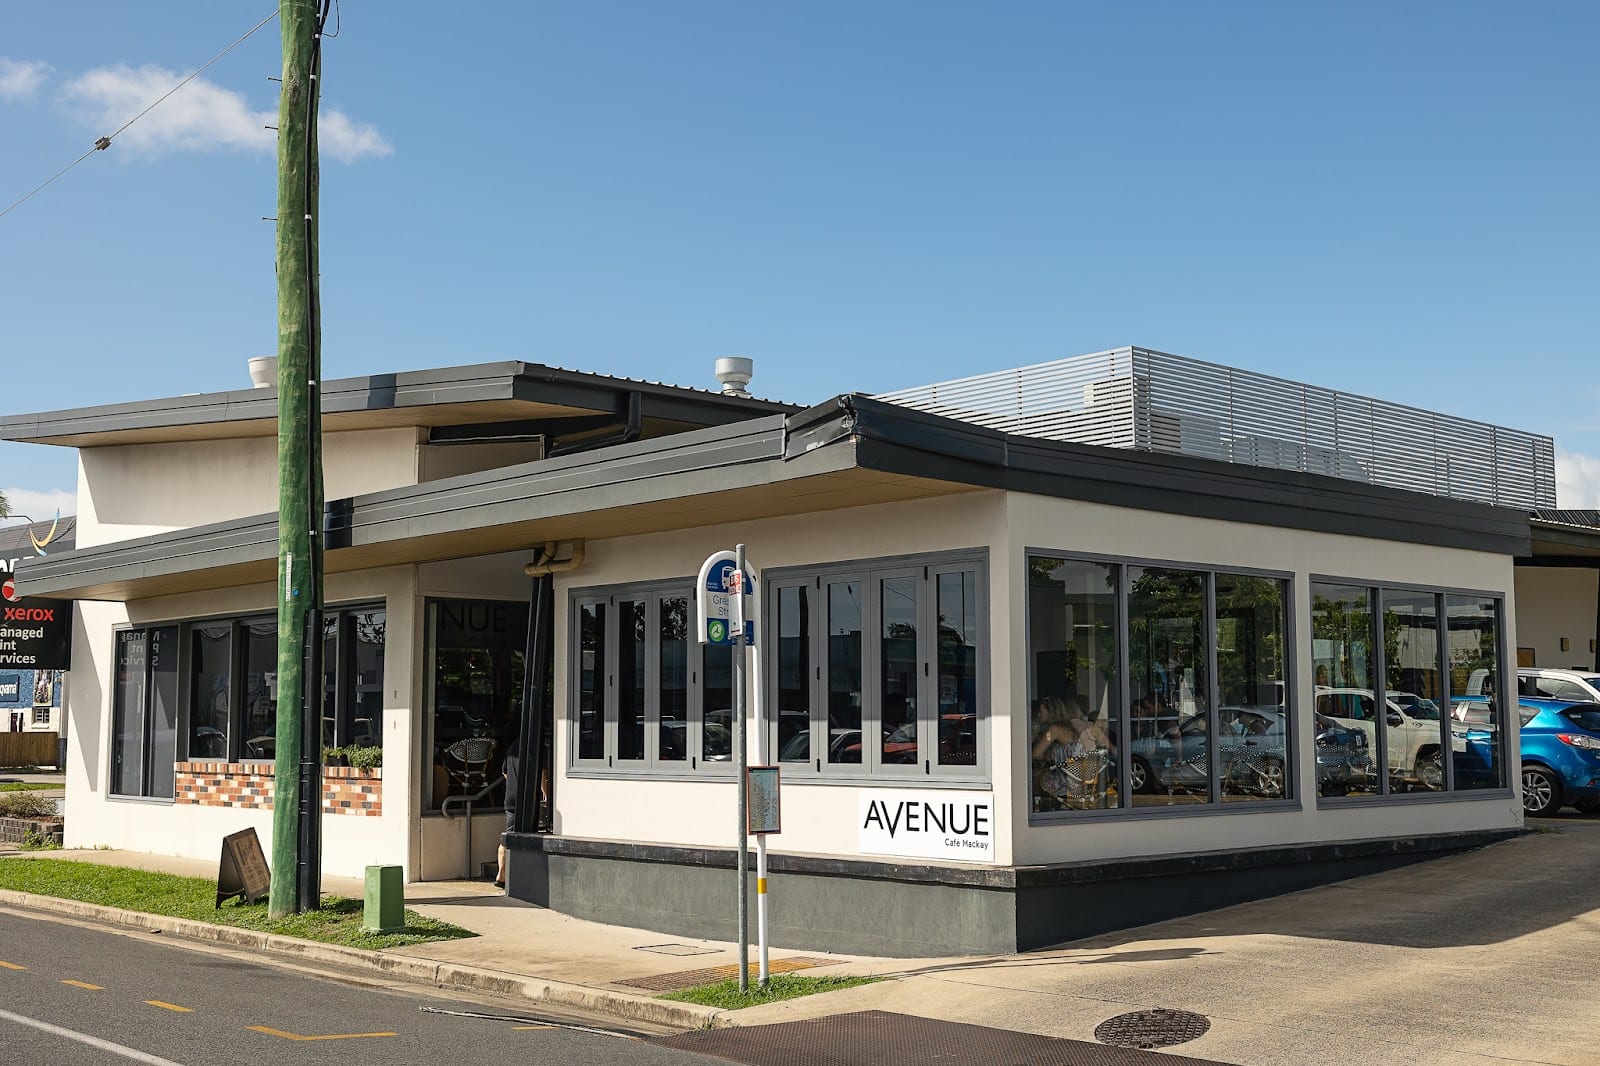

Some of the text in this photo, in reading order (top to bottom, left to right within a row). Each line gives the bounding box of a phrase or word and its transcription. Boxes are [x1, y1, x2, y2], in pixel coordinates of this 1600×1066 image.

[4, 608, 54, 621] xerox
[864, 800, 988, 838] AVENUE
[963, 840, 988, 850] Mackay
